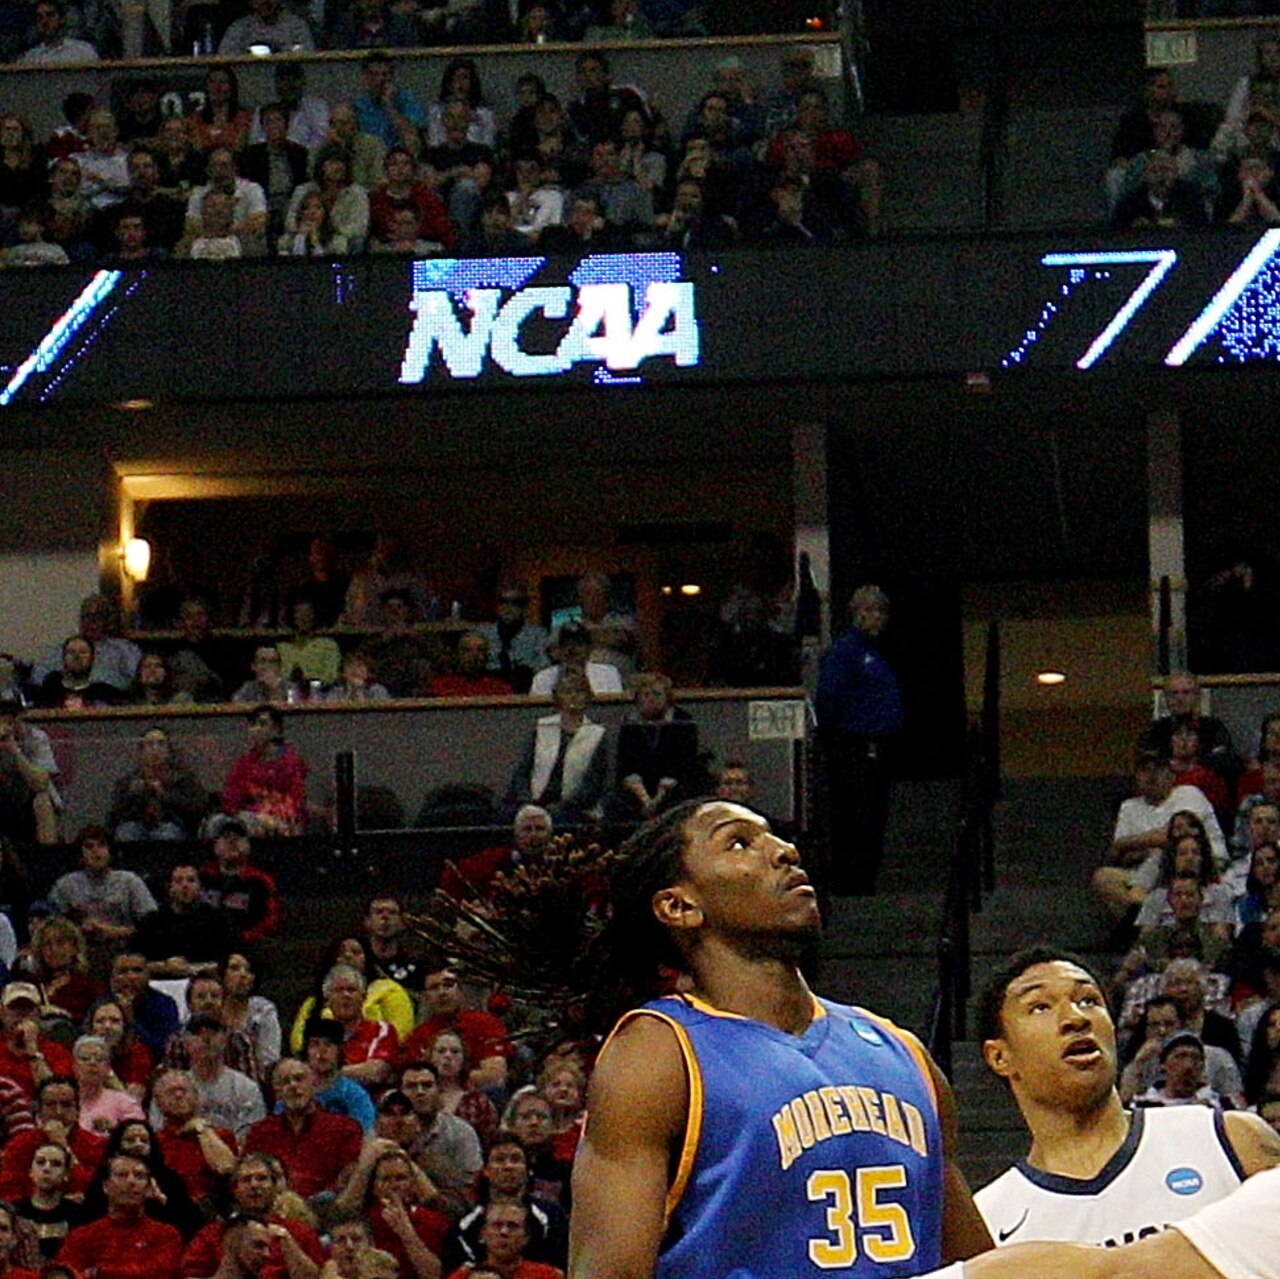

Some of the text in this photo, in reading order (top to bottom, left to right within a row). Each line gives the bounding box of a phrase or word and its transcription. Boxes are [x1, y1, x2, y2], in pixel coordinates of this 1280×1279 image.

[399, 281, 702, 386] NCAA
[773, 1084, 929, 1171] MOREHEAD
[806, 1164, 916, 1269] 35
